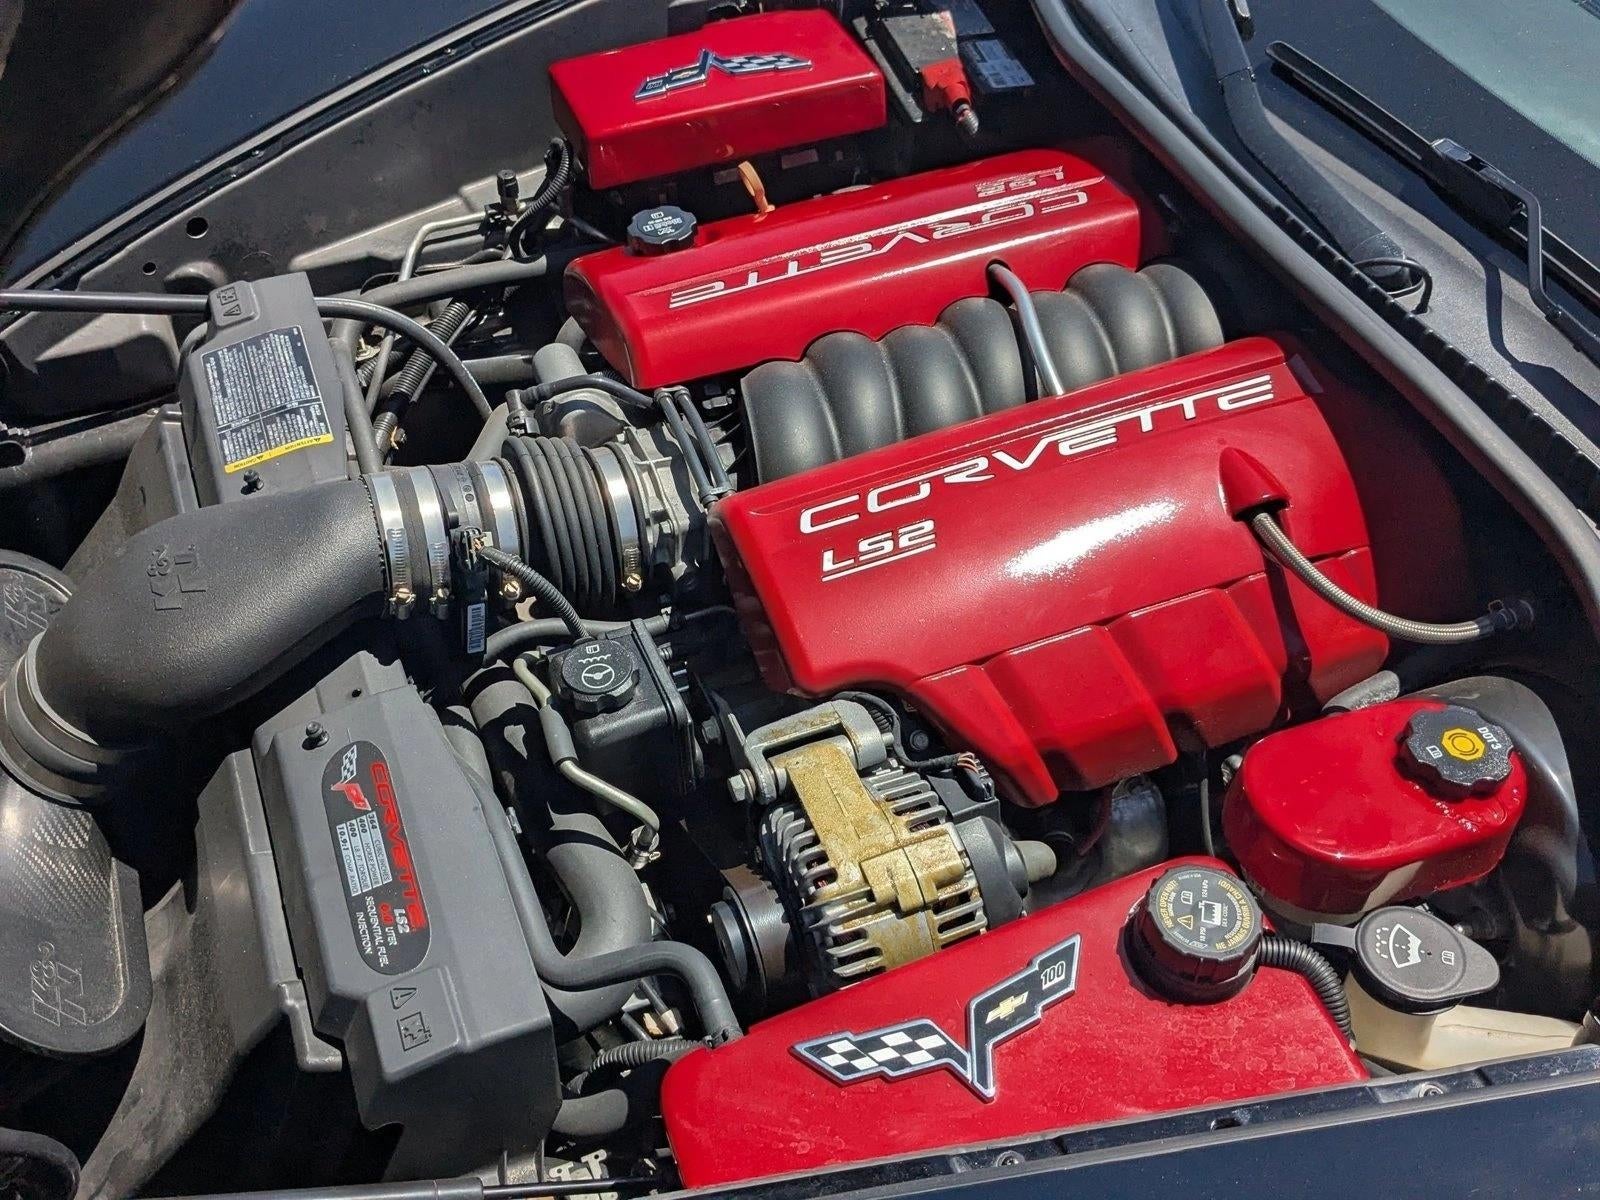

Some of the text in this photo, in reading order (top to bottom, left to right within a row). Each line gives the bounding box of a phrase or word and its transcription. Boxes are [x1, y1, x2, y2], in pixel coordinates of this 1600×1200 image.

[669, 190, 1089, 308] CORVETTE
[799, 374, 1275, 535] CORVETTE
[821, 519, 936, 576] LS2
[1477, 726, 1499, 743] DOT
[348, 822, 357, 838] 400
[358, 818, 368, 833] 400
[368, 814, 377, 829] 364
[338, 826, 349, 851] 10.9:1
[371, 763, 426, 928] CORVETTE
[355, 911, 373, 954] INJECTION
[365, 895, 389, 967] SEQUENTIAL FUEL
[394, 909, 410, 934] LS2
[1040, 960, 1066, 990] 100
